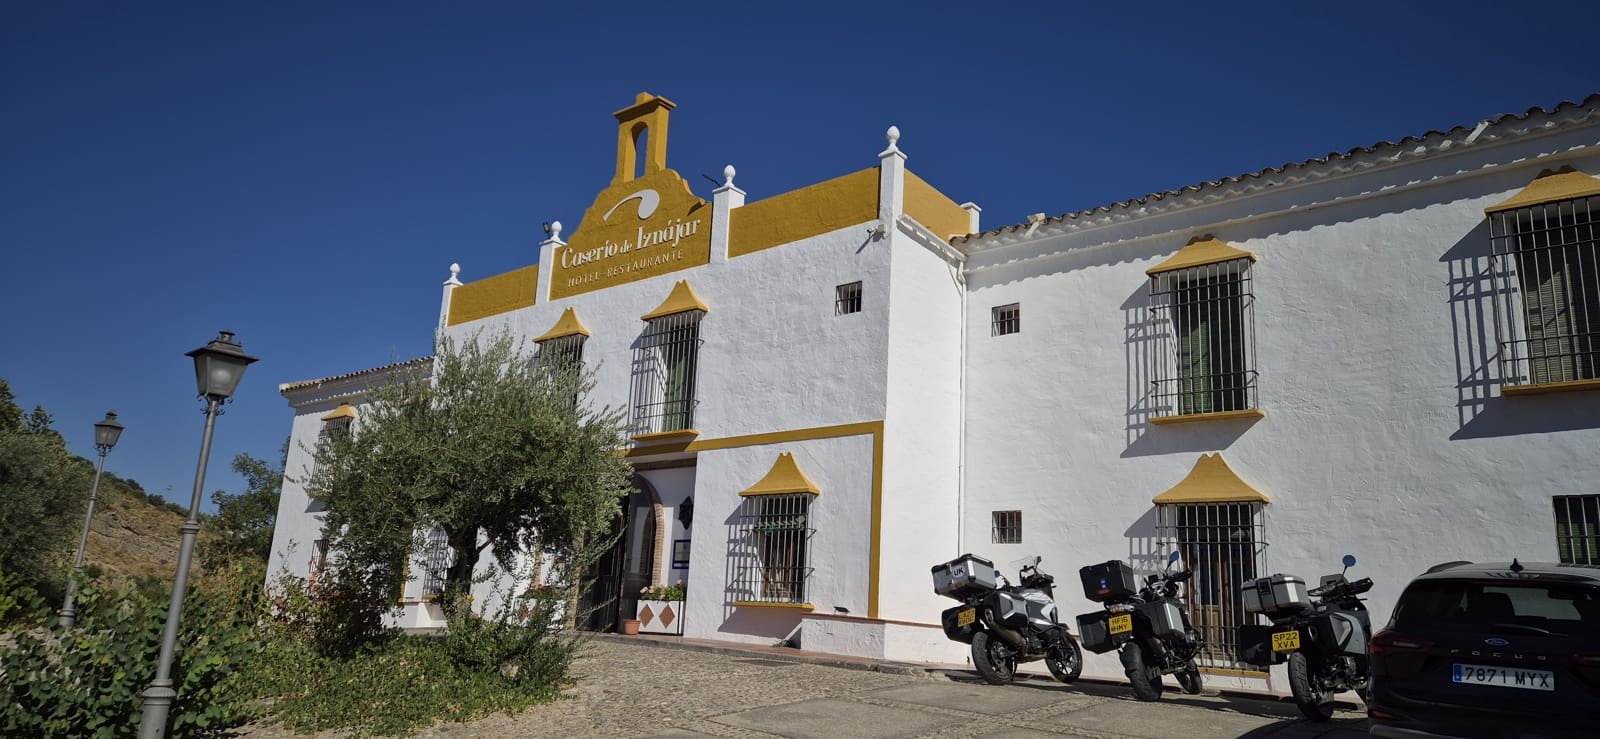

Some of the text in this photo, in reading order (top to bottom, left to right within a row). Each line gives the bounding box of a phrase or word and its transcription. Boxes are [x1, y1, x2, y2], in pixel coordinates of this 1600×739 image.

[561, 218, 701, 269] Caserío de Iznájar
[953, 567, 964, 576] UK
[1273, 631, 1298, 641] SP22
[1277, 640, 1295, 649] XVA
[1450, 649, 1546, 660] FOCUS
[1465, 666, 1549, 688] 7871 MYX
